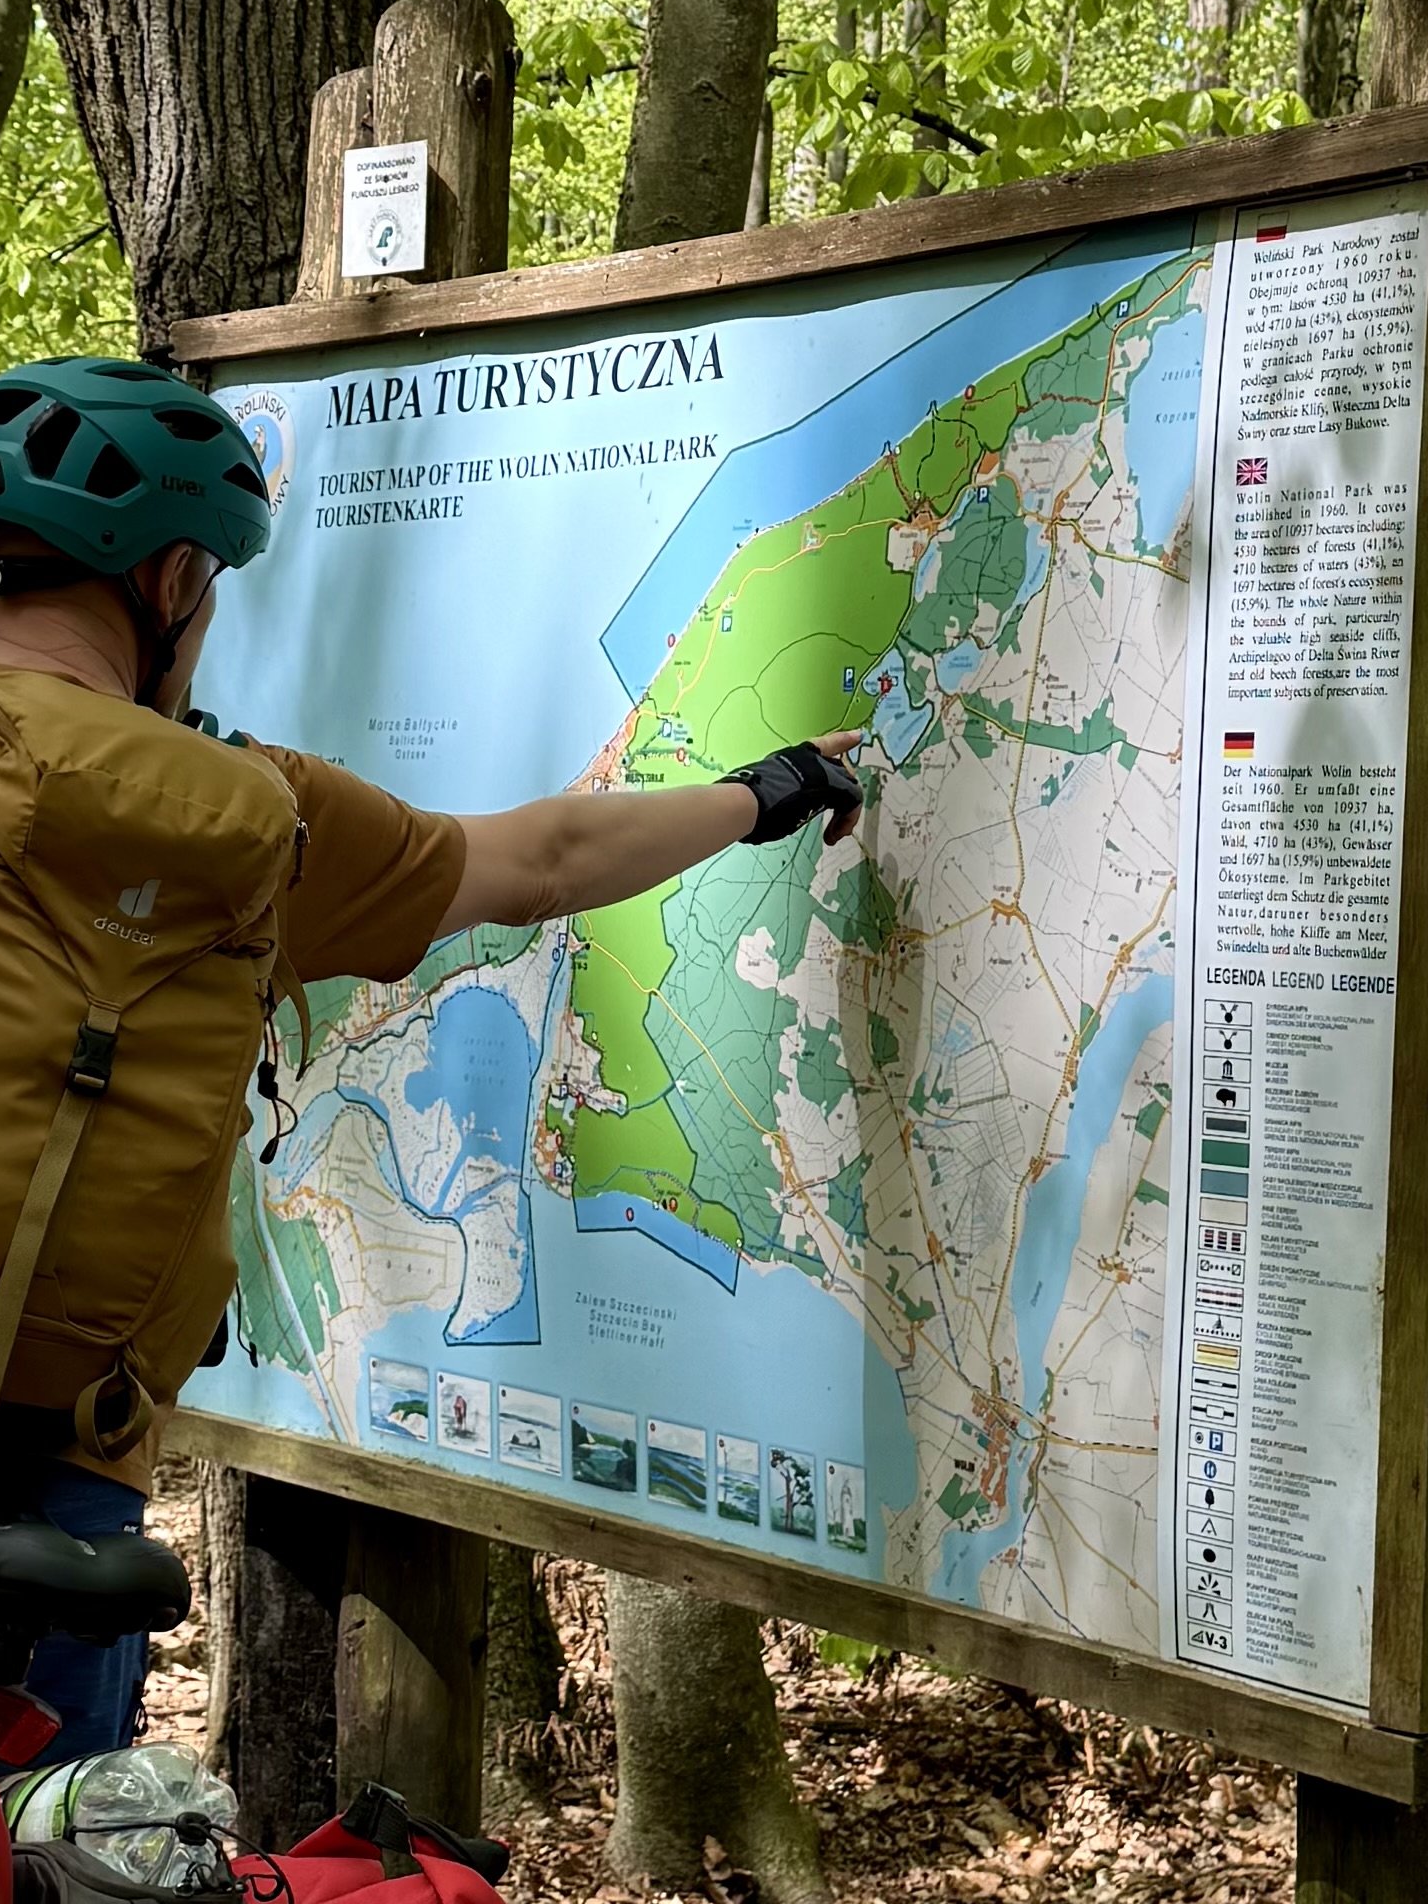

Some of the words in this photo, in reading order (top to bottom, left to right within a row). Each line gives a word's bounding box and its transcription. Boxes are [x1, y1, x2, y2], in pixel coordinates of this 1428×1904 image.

[1254, 247, 1294, 264] Woliński
[1303, 245, 1323, 258] Park
[1332, 234, 1381, 253] Narodowy
[1251, 263, 1323, 282] utworzony
[1336, 254, 1368, 270] 1960
[1379, 249, 1418, 263] roku.
[1249, 282, 1298, 300] Obejmuje
[1306, 277, 1348, 291] ochroną
[1358, 268, 1390, 284] 10937
[1244, 358, 1253, 369] W
[1261, 350, 1312, 370] granicach
[1323, 348, 1354, 360] Parku
[1363, 341, 1413, 356] ochronie
[327, 376, 422, 429] MAPA
[433, 331, 724, 416] TURYSTYCZNA
[1241, 372, 1277, 390] podlega
[1375, 363, 1385, 372] w
[1240, 389, 1304, 405] szczególnie
[1314, 384, 1351, 397] cenne,
[1363, 377, 1411, 395] wysokie
[1242, 406, 1298, 422] Nadmorskie
[1333, 399, 1380, 413] Wsteczna
[1383, 395, 1410, 409] Delta
[1270, 425, 1290, 437] oraz
[1293, 422, 1315, 435] stare
[1346, 417, 1389, 430] Bukowe.
[319, 468, 385, 498] TOURIST
[388, 466, 426, 489] MAP
[429, 461, 453, 487] OF
[457, 458, 493, 484] THE
[500, 451, 562, 480] WOLIN
[565, 439, 660, 474] NATIONAL
[663, 433, 720, 462] PARK
[160, 474, 207, 498] uvex
[1237, 493, 1271, 504] Wolin
[1281, 486, 1334, 502] National
[1345, 483, 1373, 497] Park
[1384, 483, 1407, 494] was
[316, 496, 464, 529] TOURISTENKARTE
[1235, 509, 1292, 522] established
[1301, 505, 1311, 518] in
[1321, 504, 1348, 517] 1960.
[1375, 502, 1406, 514] coves
[1233, 581, 1255, 592] 1697
[1258, 581, 1295, 592] hectares
[1299, 578, 1310, 590] of
[1276, 596, 1293, 609] The
[1300, 596, 1328, 608] whole
[1372, 592, 1402, 605] within
[1231, 616, 1244, 628] the
[1295, 613, 1306, 626] of
[1230, 634, 1244, 645] the
[1252, 632, 1292, 644] valuable
[1300, 631, 1321, 646] high
[1329, 630, 1364, 643] seaside
[1224, 765, 1241, 777] Der
[1249, 765, 1312, 780] Nationalpark
[1322, 765, 1352, 777] Wolin
[1360, 765, 1396, 778] besteht
[1223, 782, 1243, 795] seit
[1253, 783, 1284, 795] 1960.
[1295, 784, 1308, 795] Er
[1369, 783, 1396, 796] eine
[1222, 800, 1294, 813] Gesamtfläche
[1304, 804, 1324, 813] von
[1334, 802, 1367, 814] 10937
[1218, 868, 1289, 885] Ökosysteme.
[1299, 872, 1314, 884] Im
[1320, 908, 1388, 923] besonders
[93, 916, 157, 945] deuter
[1270, 925, 1295, 937] hohe
[1300, 925, 1330, 939] Kliffe
[1336, 931, 1351, 940] am
[1207, 967, 1266, 987] LEGENDA
[1273, 971, 1324, 989] LEGEND
[1332, 974, 1395, 994] LEGENDE
[1205, 1631, 1227, 1649] V-3
